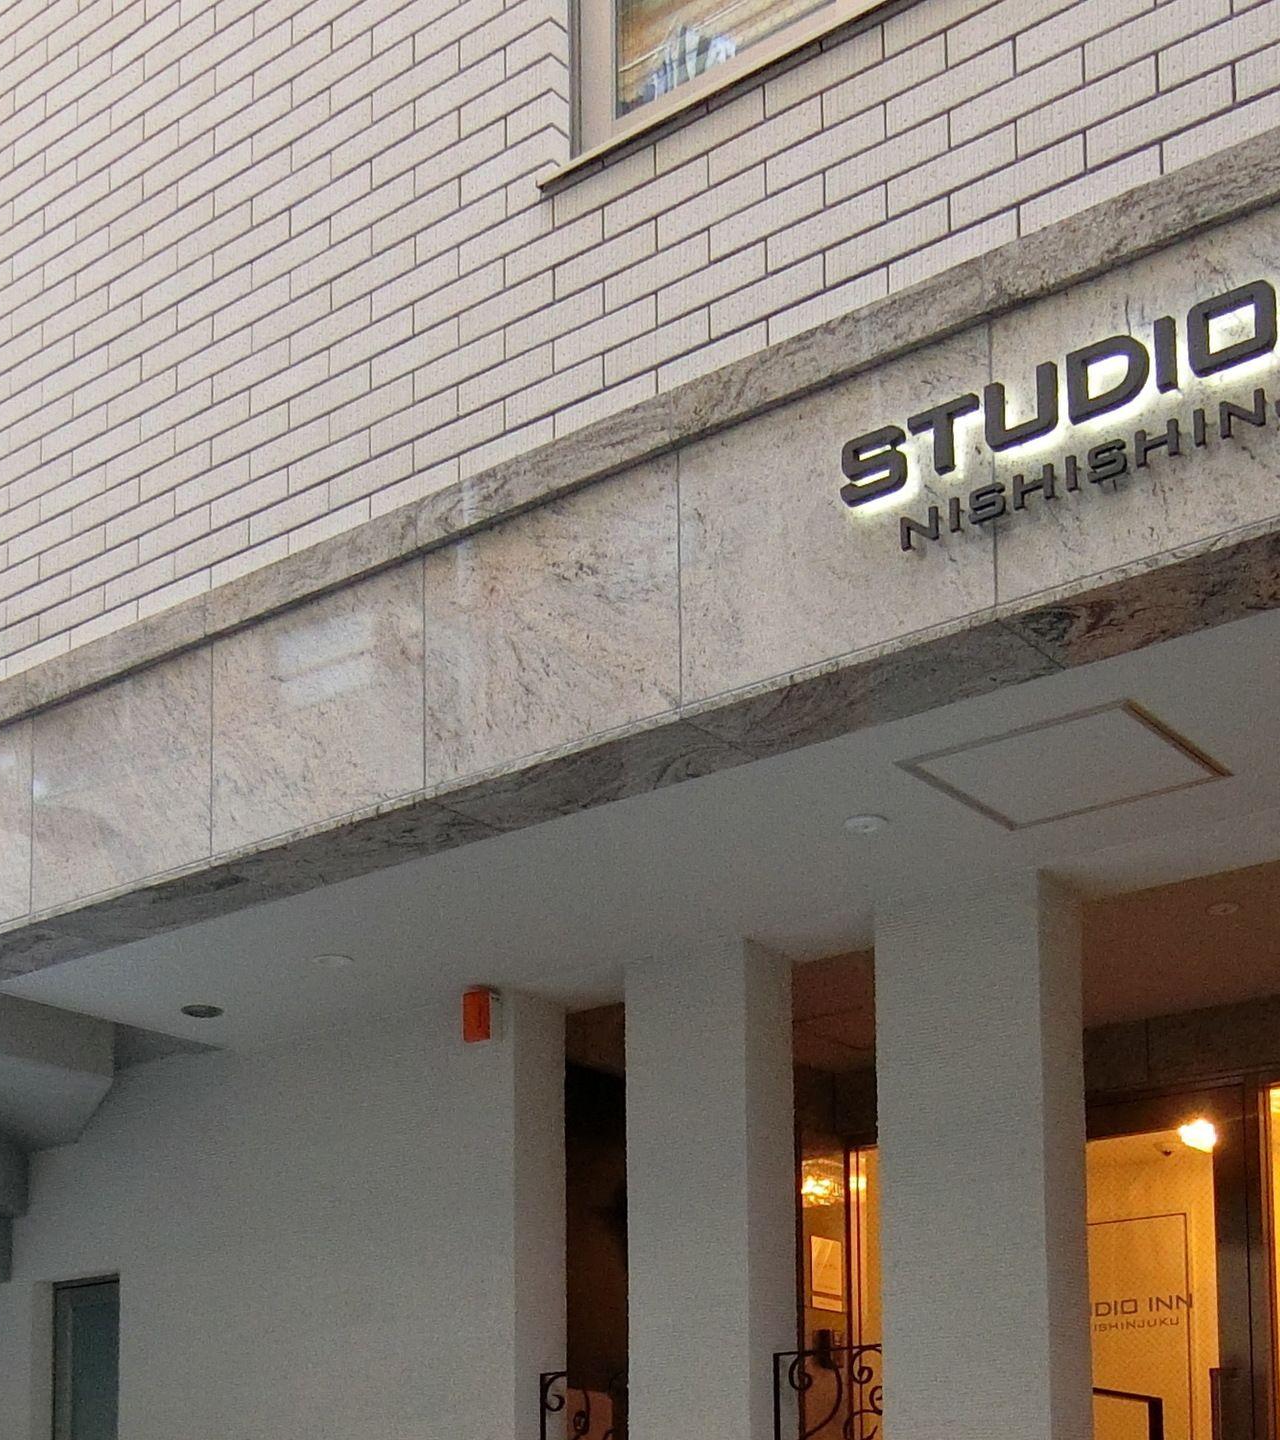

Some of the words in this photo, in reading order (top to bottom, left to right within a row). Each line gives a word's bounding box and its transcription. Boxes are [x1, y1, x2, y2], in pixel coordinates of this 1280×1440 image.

[840, 279, 1277, 508] STUDIO
[1091, 1298, 1138, 1317] DIO
[1149, 1293, 1193, 1312] INN
